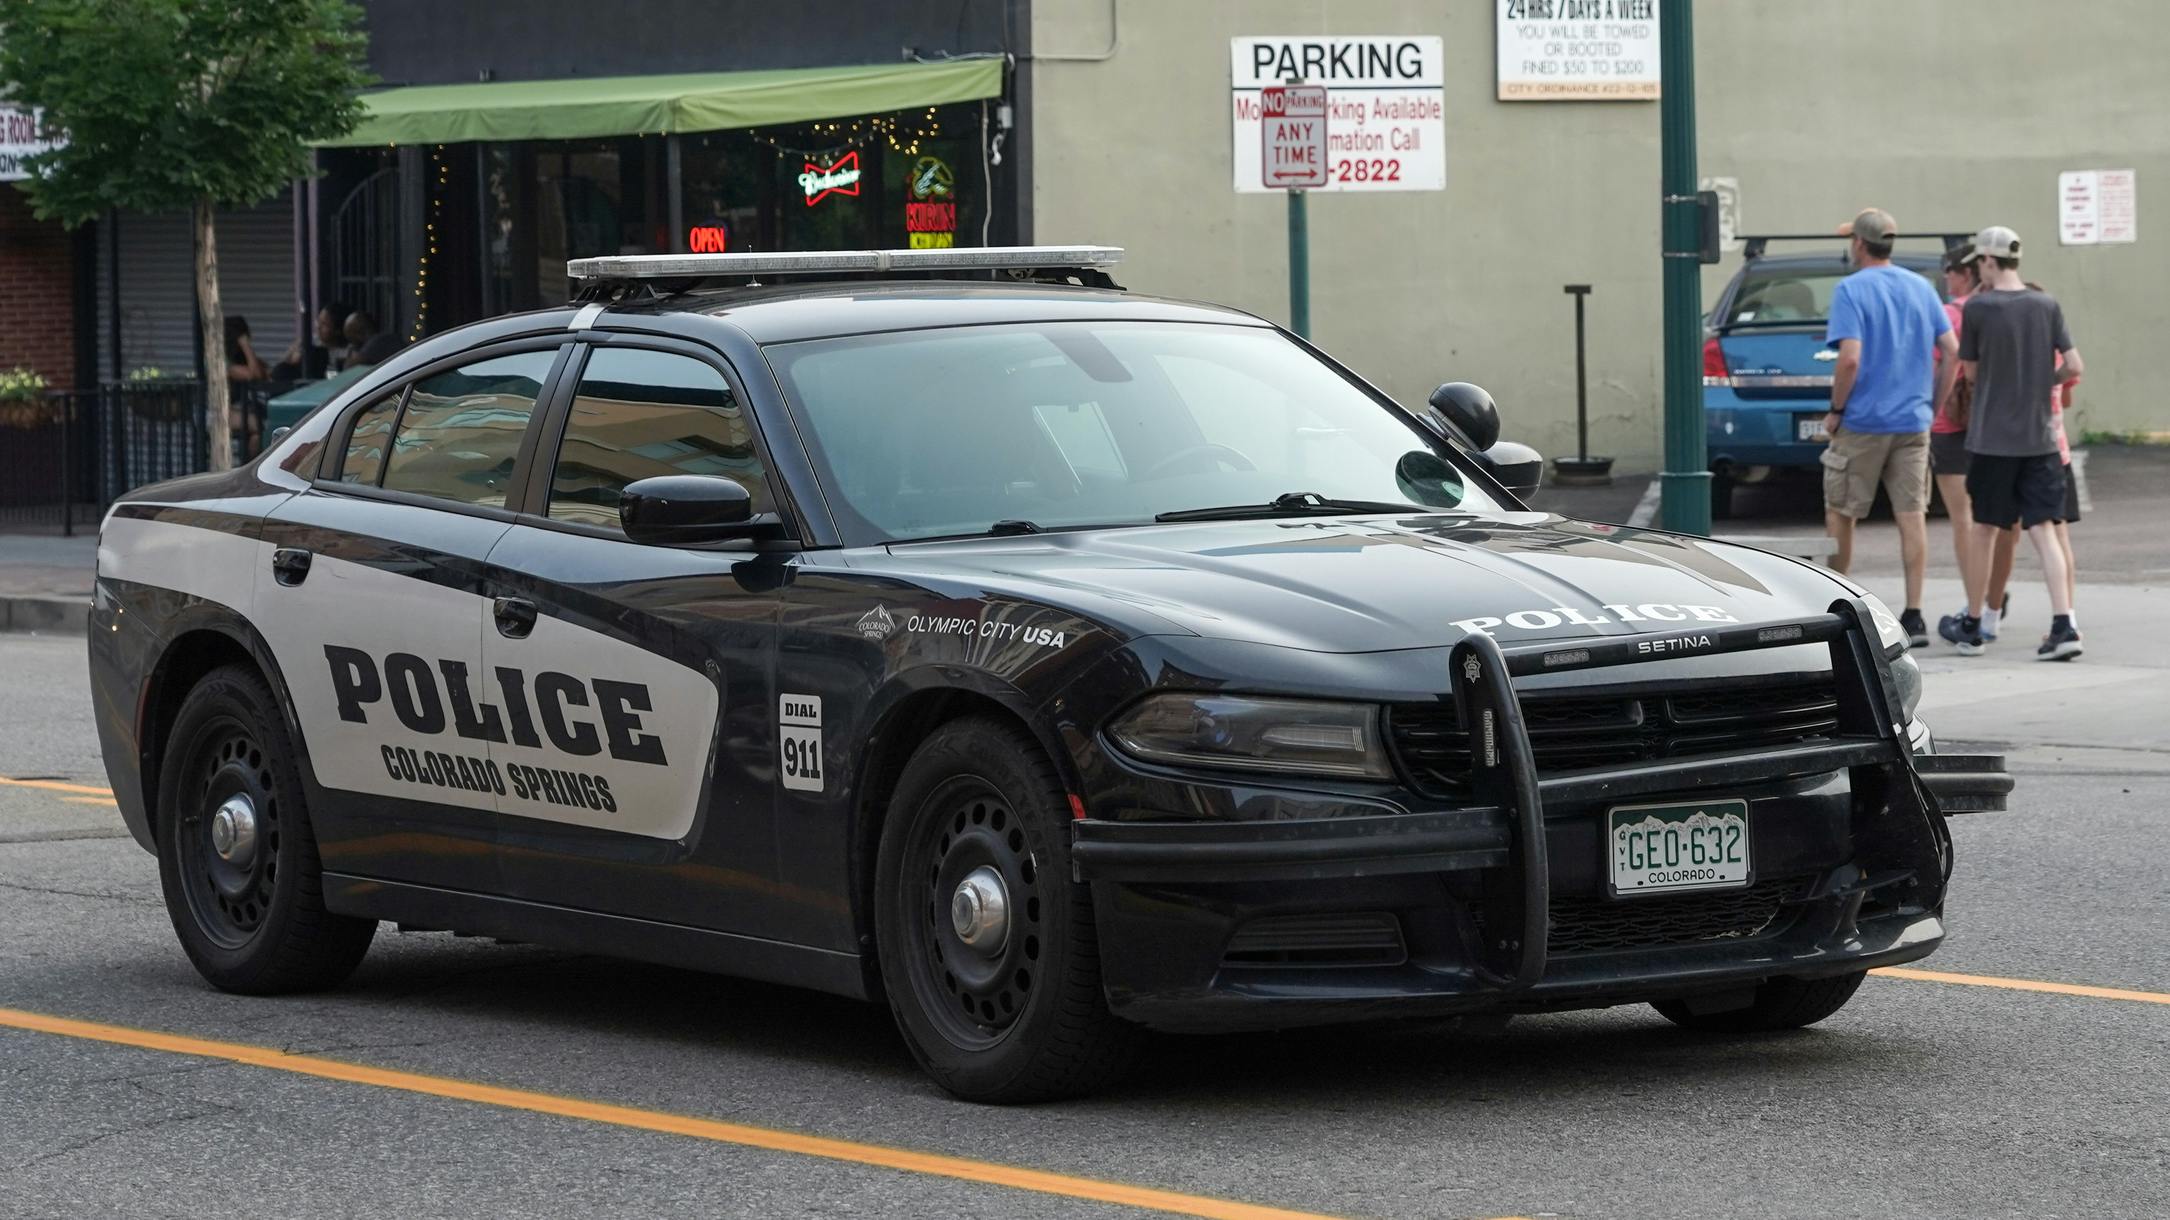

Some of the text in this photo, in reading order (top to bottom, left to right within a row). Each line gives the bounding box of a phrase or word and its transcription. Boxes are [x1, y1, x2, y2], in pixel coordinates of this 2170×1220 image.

[1568, 0, 1600, 19] DAYS
[1605, 0, 1613, 19] A
[1618, 0, 1654, 19] WEEK
[1516, 25, 1650, 39] YOU WILL BE TOWED
[1544, 43, 1622, 57] OR BOOTED
[1253, 43, 1422, 79] PARKING
[1522, 60, 1643, 75] FINED $50 TO $200
[1263, 92, 1284, 112] NO
[1285, 95, 1323, 108] PARKING
[1373, 98, 1441, 120] Available
[1276, 122, 1313, 141] ANY
[1329, 128, 1420, 151] mation Call
[1273, 145, 1317, 164] TIME
[1328, 159, 1401, 182] -2822
[690, 227, 724, 253] OPEN
[858, 621, 891, 634] COLORADO
[1448, 603, 1740, 637] POLICE
[907, 615, 1066, 649] OLYMPIC CITY USA
[1638, 635, 1711, 654] SETINA
[323, 643, 669, 767] POLICE
[785, 702, 817, 718] DIAL
[783, 737, 820, 779] 911
[380, 744, 618, 814] COLORADO SPRINGS
[1648, 868, 1715, 884] COLORADO
